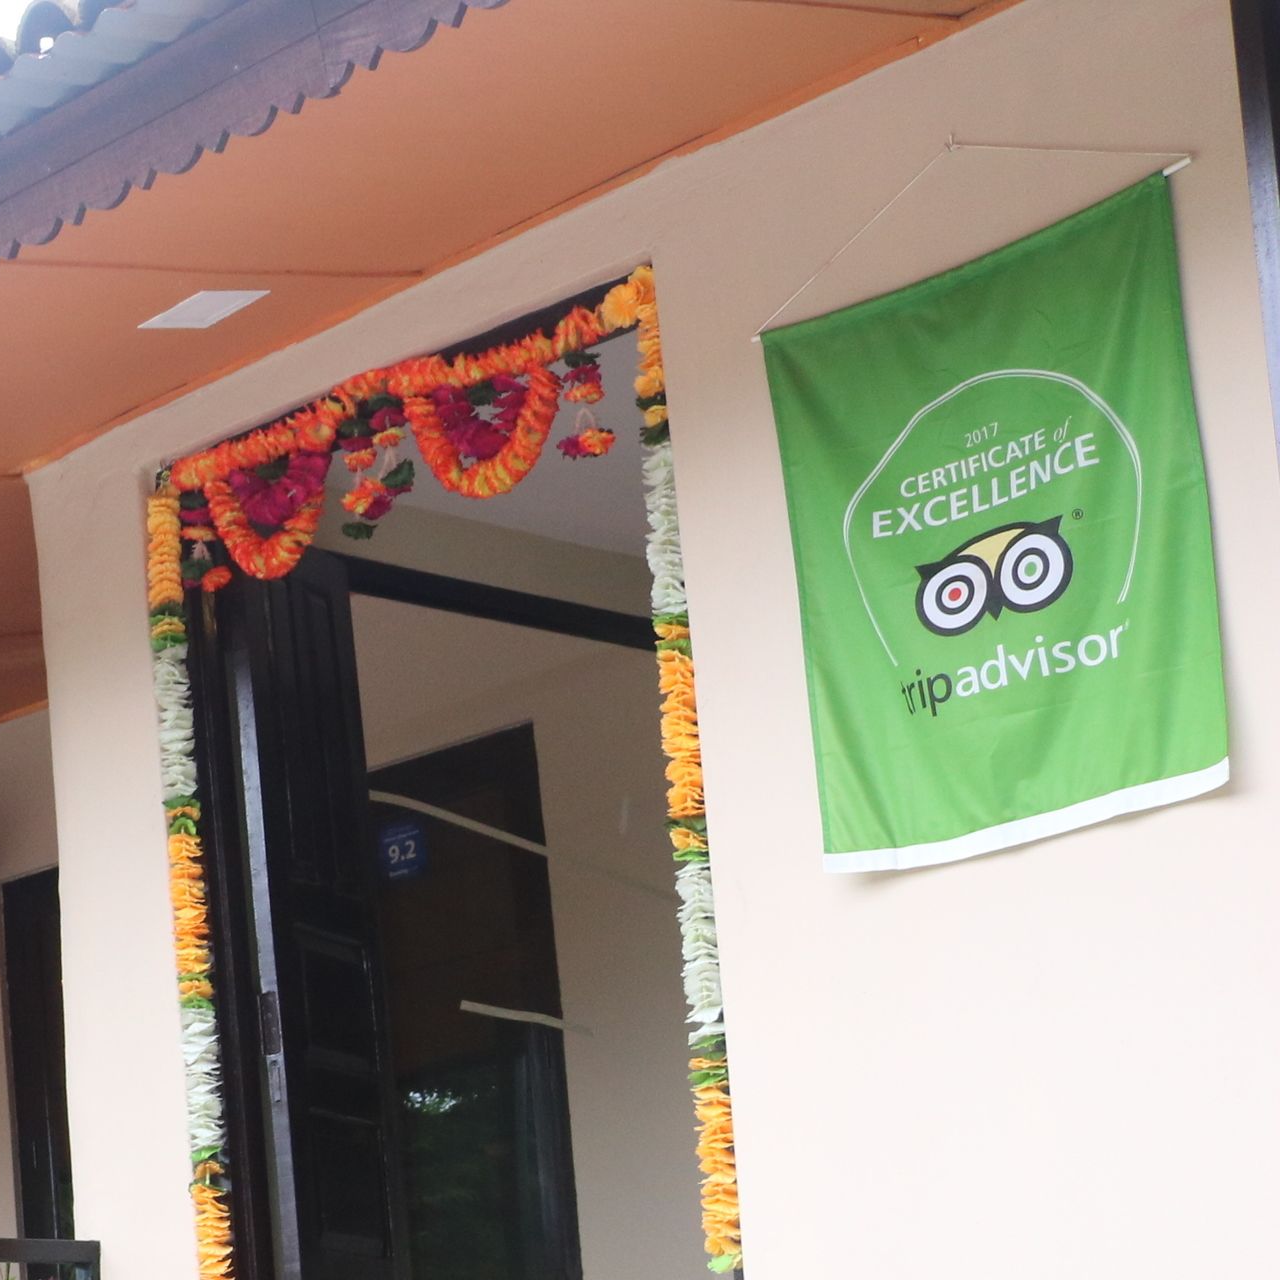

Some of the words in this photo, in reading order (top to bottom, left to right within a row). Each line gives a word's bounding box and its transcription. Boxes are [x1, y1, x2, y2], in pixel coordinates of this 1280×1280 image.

[900, 428, 1047, 498] CERTIFICATE
[1053, 415, 1072, 443] of
[964, 421, 999, 448] 2017
[871, 432, 1101, 538] EXCELLENCE
[388, 839, 417, 865] 9.2
